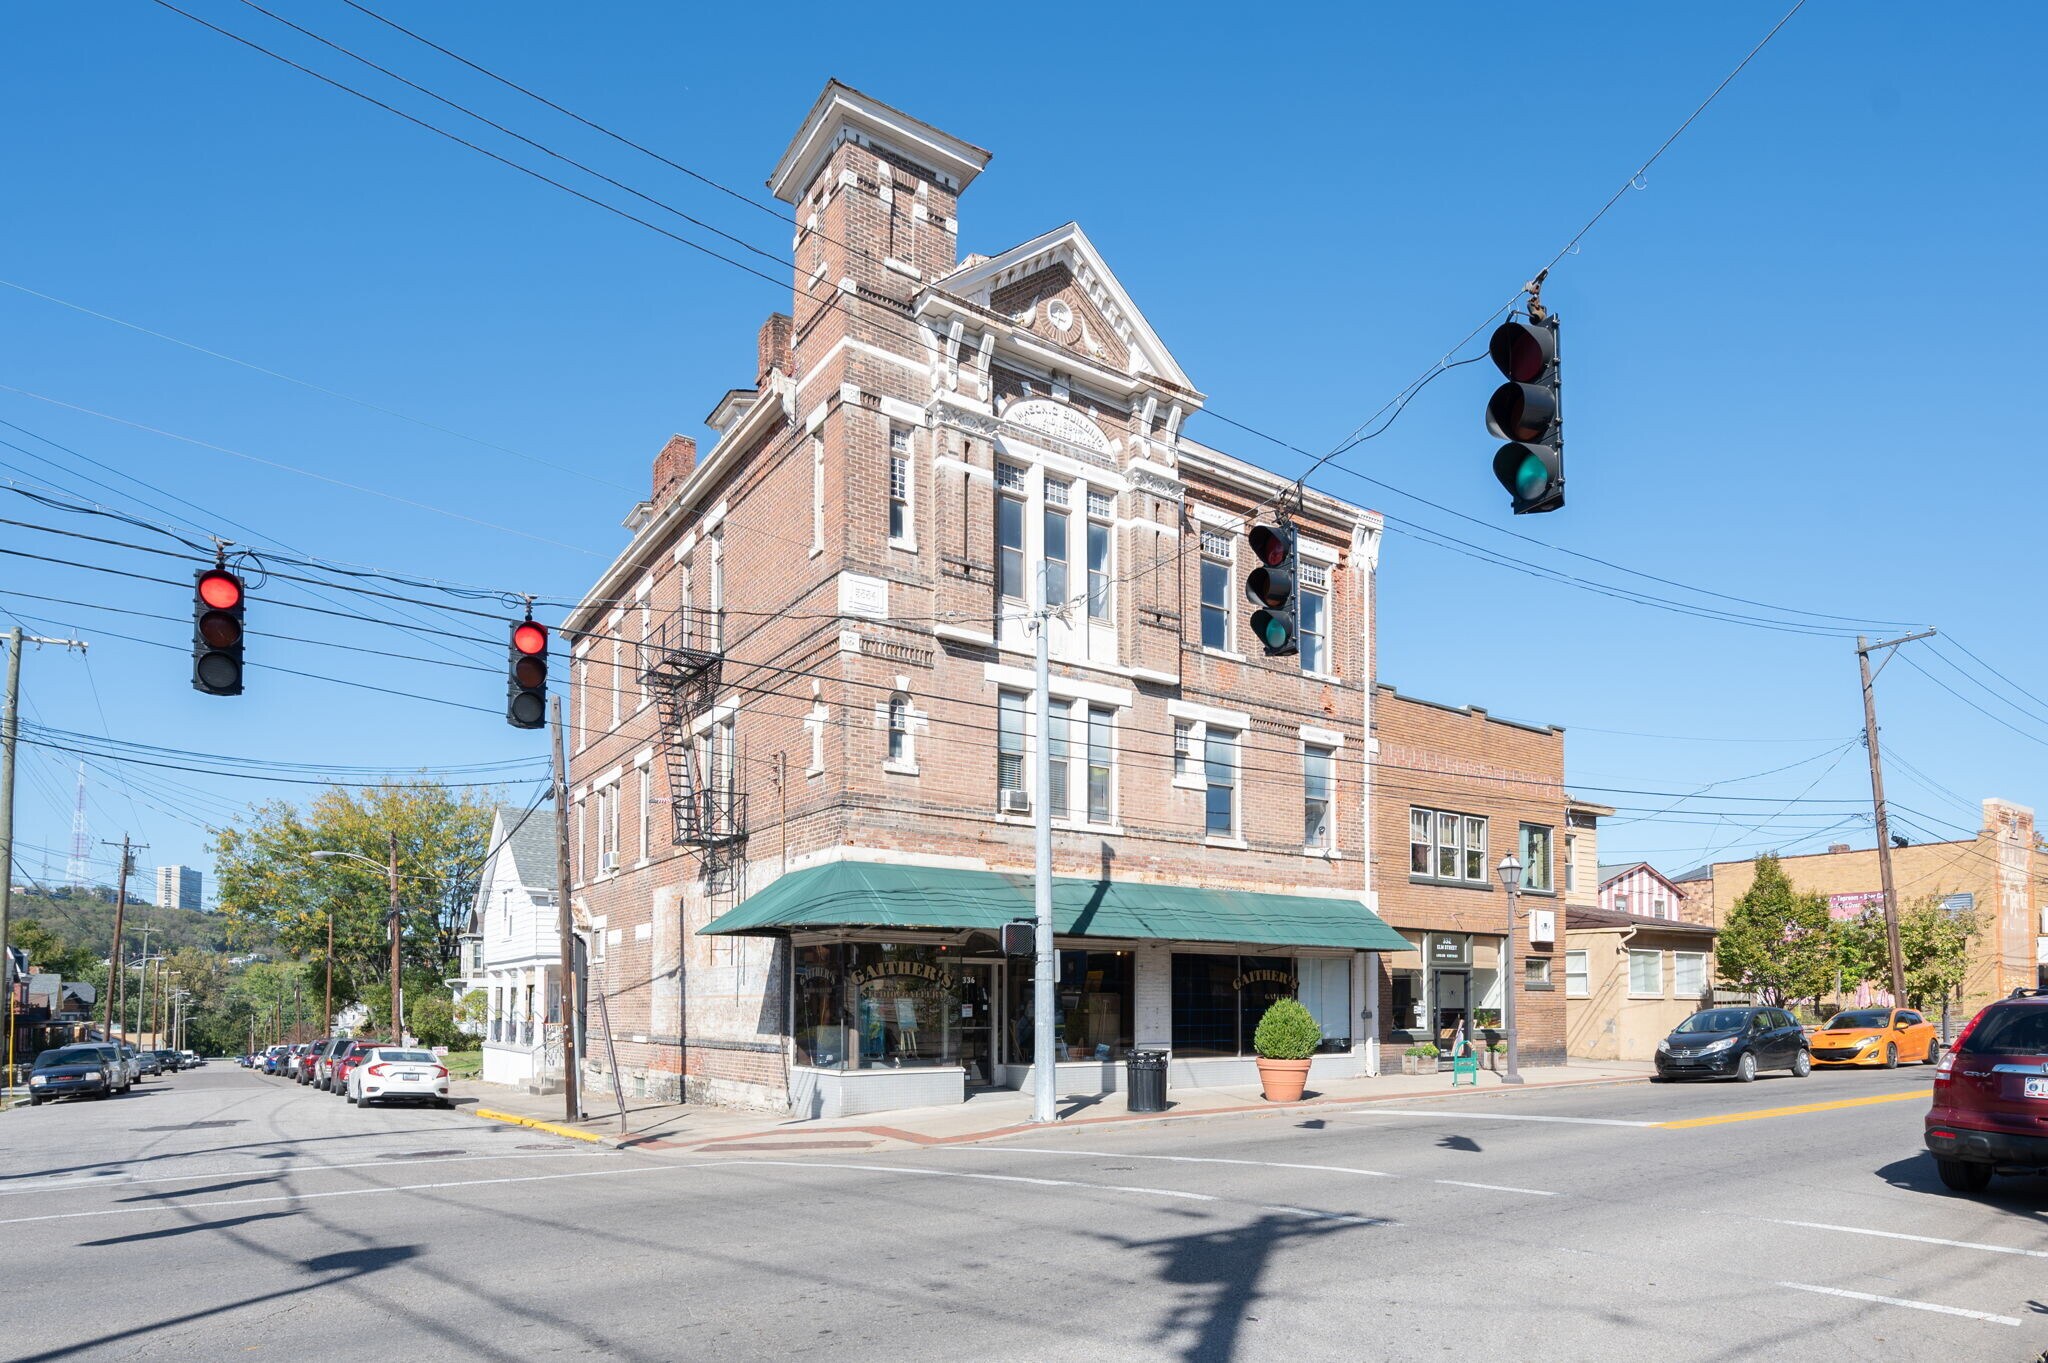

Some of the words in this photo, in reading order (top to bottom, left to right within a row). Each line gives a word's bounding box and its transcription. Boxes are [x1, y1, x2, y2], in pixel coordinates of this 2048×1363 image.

[1014, 403, 1059, 421] MASONIC
[1063, 410, 1105, 449] BUILDING
[850, 960, 954, 990] GAITHER'S
[962, 976, 976, 984] 336
[1232, 969, 1298, 990] GAITHER'S
